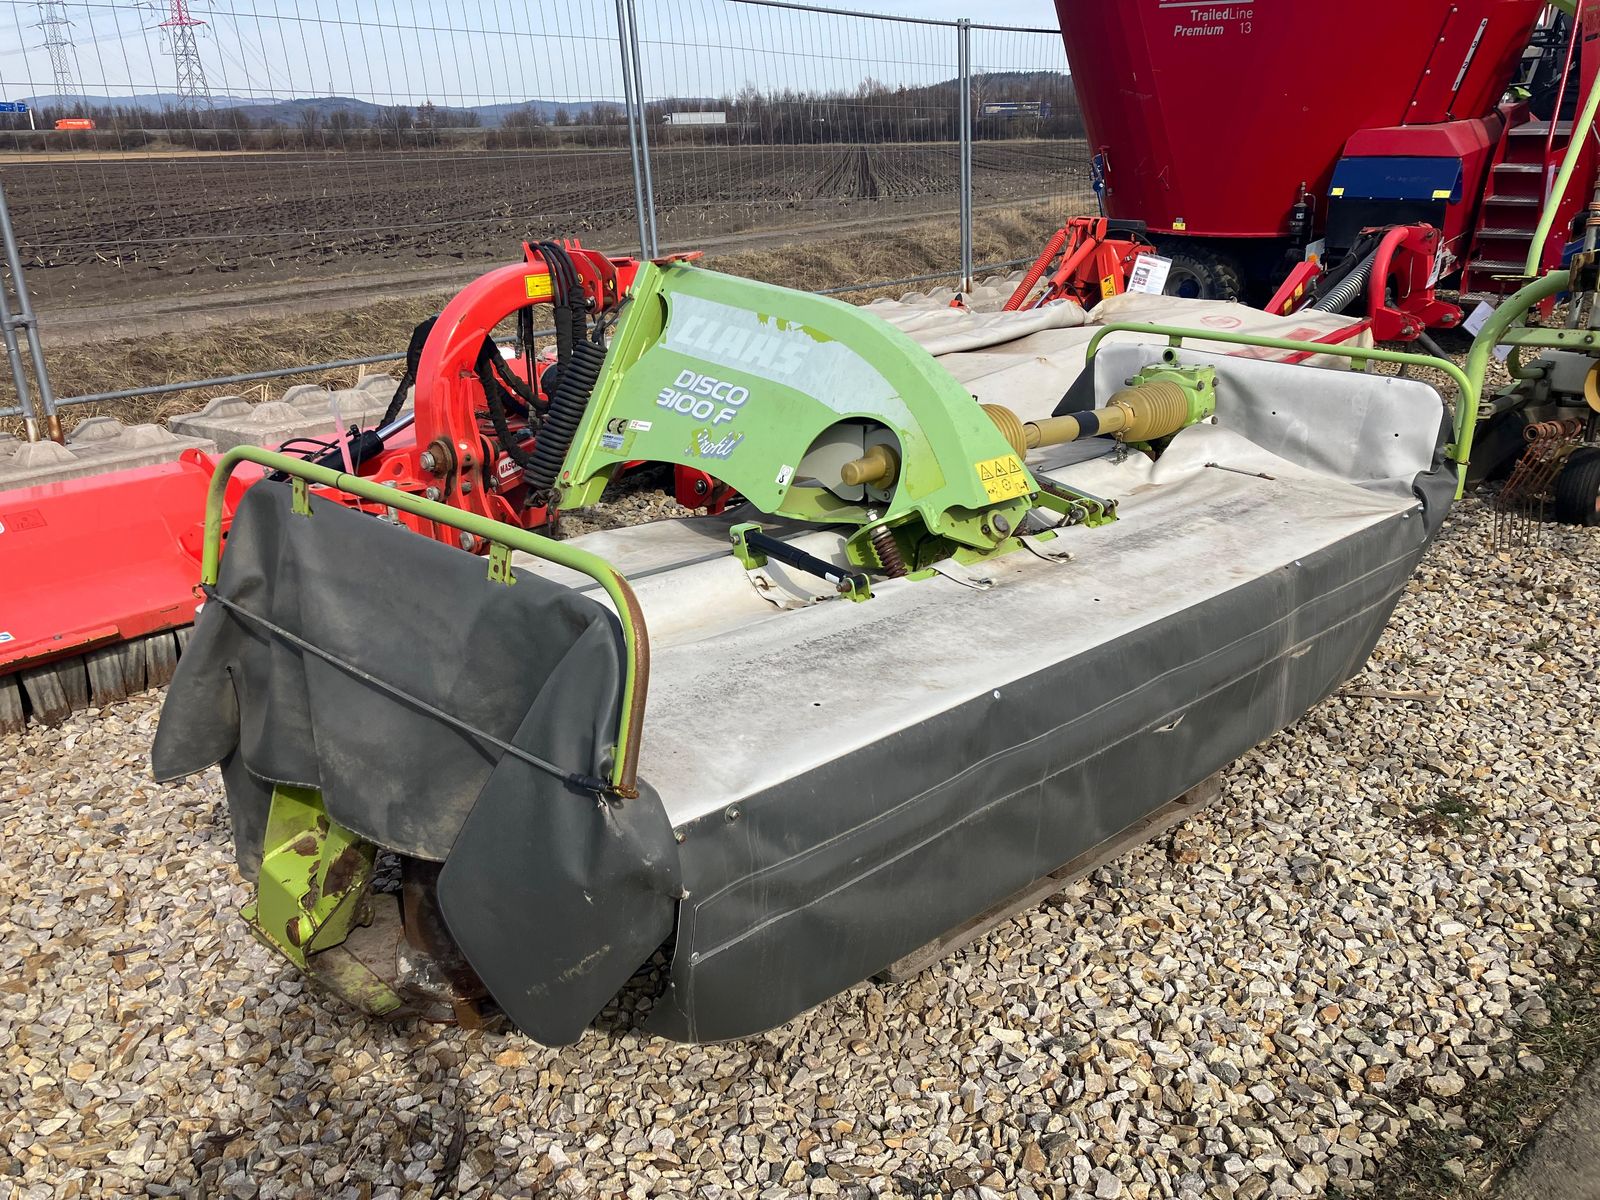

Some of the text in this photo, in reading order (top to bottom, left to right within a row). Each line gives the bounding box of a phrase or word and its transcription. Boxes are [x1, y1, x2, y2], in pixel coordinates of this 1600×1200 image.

[1190, 8, 1254, 21] TrailedLine
[1173, 22, 1252, 37] Premium 13
[674, 315, 812, 375] CLAAS
[673, 368, 751, 407] DISCO
[655, 386, 738, 425] 3100 F
[500, 461, 518, 475] MASC
